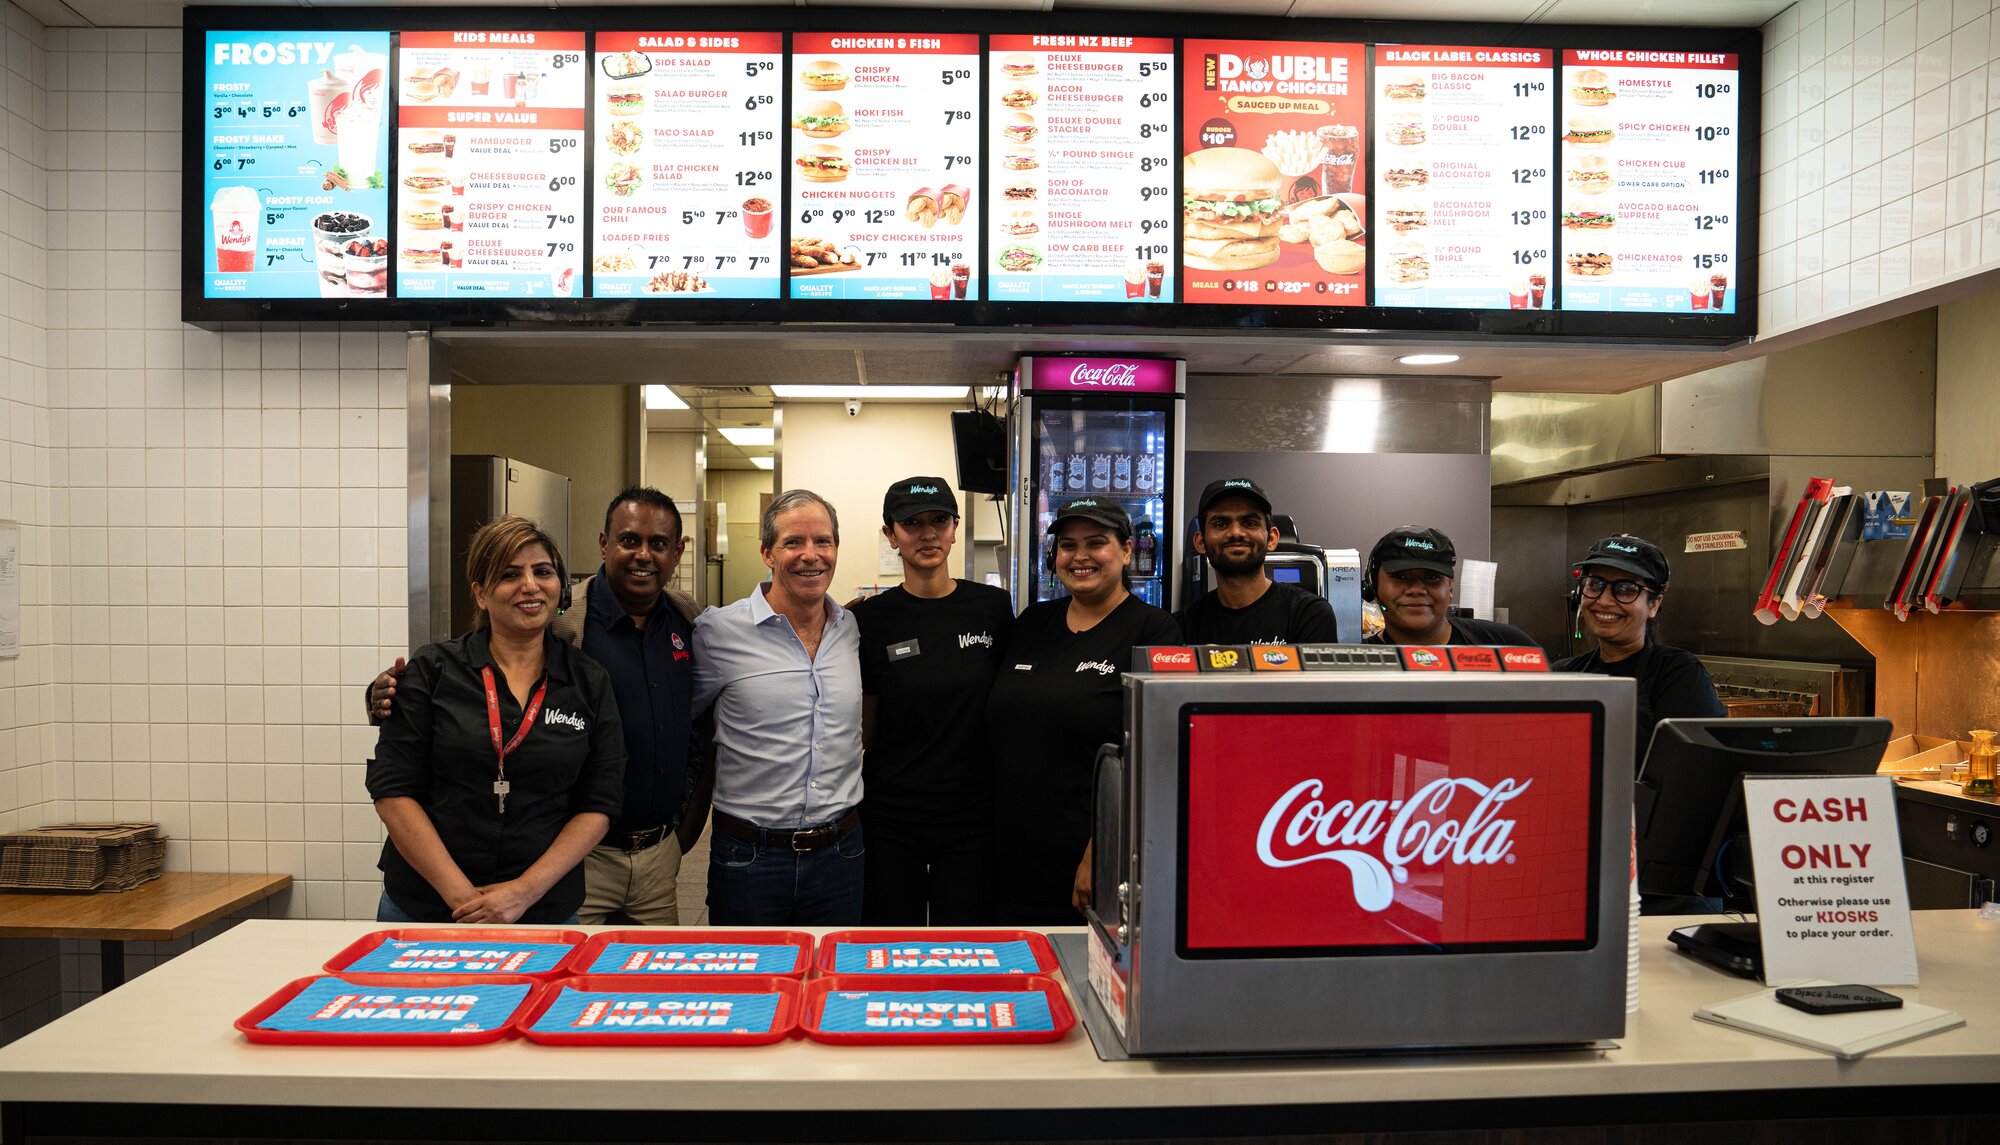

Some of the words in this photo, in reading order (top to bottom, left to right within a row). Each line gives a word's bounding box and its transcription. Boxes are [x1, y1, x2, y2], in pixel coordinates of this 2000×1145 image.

[454, 32, 487, 43] KIDS
[490, 33, 535, 44] MEALS
[638, 37, 685, 47] SALAD
[687, 38, 697, 47] &
[700, 37, 740, 48] SIDES
[1033, 36, 1076, 47] FRESH
[1079, 37, 1099, 47] NZ
[1102, 37, 1133, 47] BEEF
[831, 38, 894, 49] CHICKEN
[898, 39, 907, 49] &
[910, 39, 941, 49] FISH
[214, 42, 334, 65] FROSTY
[1386, 51, 1431, 62] BLACK
[1434, 52, 1472, 62] LABEL
[1475, 52, 1541, 63] CLASSICS
[1576, 51, 1623, 61] WHOLE
[1626, 51, 1685, 63] CHICKEN
[1688, 53, 1726, 64] FILLET
[655, 59, 676, 67] SIDE
[679, 59, 711, 67] SALAD
[1048, 64, 1123, 72] CHEESEBURGER
[1206, 58, 1216, 86] NEW
[1220, 54, 1348, 82] DUBLE
[1220, 80, 1275, 93] TANGY
[1277, 81, 1348, 96] CHICKEN
[1432, 82, 1472, 90] CLASSIC
[1619, 80, 1672, 88] HOMESTYLE
[655, 90, 686, 98] SALAD
[689, 90, 728, 98] BURGER
[1048, 94, 1123, 102] CHEESEBURGER
[1238, 101, 1277, 109] SAUCED
[1279, 102, 1292, 110] UP
[1293, 103, 1319, 111] MEAL
[855, 109, 879, 117] HOKI
[882, 109, 904, 117] FISH
[448, 112, 492, 123] SUPER
[495, 113, 537, 124] VALUE
[1048, 117, 1083, 125] DELUXE
[1086, 117, 1122, 125] DOUBLE
[1048, 126, 1091, 134] STACKER
[1619, 123, 1646, 131] SPICY
[1648, 124, 1690, 132] CHICKEN
[654, 129, 680, 137] TACO
[683, 129, 714, 137] SALAD
[214, 136, 251, 144] FROSTY
[253, 135, 284, 143] SHAKE
[470, 138, 532, 146] HAMBURGER
[855, 149, 891, 157] CRISPY
[1100, 151, 1134, 159] SINGLE
[855, 158, 899, 166] CHICKEN
[903, 158, 918, 166] BLT
[1619, 160, 1660, 168] CHICKEN
[470, 173, 546, 181] CHEESEBURGER
[1433, 170, 1491, 178] BACONATOR
[802, 191, 847, 199] CHICKEN
[850, 191, 896, 199] NUGGETS
[1048, 188, 1109, 196] BACONATOR
[266, 197, 304, 205] FROSTY
[305, 196, 334, 205] FLOAT
[508, 204, 552, 212] CHICKEN
[1618, 203, 1664, 211] AVOCADO
[469, 212, 507, 220] BURGER
[1048, 211, 1082, 219] SINGLE
[221, 234, 251, 245] Wendy's
[266, 237, 305, 246] PARFAIT
[603, 234, 640, 242] LOADED
[643, 234, 670, 242] FRIES
[850, 234, 879, 242] SPICY
[883, 234, 927, 242] CHICKEN
[468, 249, 543, 257] CHEESEBURGER
[1618, 254, 1683, 262] CHICKENATOR
[1236, 280, 1259, 292] $18
[1070, 363, 1140, 386] Coca-Cola
[958, 631, 993, 649] Wendy's
[1075, 660, 1115, 675] Wendy's
[545, 708, 585, 731] Wendy's
[1773, 797, 1868, 823] CASH
[1256, 776, 1533, 912] Coca-Cola
[1781, 844, 1871, 870] ONLY
[1793, 875, 1804, 884] at
[1807, 875, 1828, 884] this
[1831, 875, 1874, 886] register
[1778, 897, 1833, 907] Otherwise
[1836, 897, 1870, 908] please
[1873, 898, 1890, 906] use
[1795, 914, 1813, 922] our
[1816, 911, 1878, 923] KIOSKS
[1787, 929, 1798, 938] to
[1801, 929, 1828, 940] place
[1832, 929, 1857, 940] your
[1860, 929, 1893, 938] order.
[647, 963, 758, 971] NAME
[893, 959, 1000, 968] NAME
[340, 1009, 470, 1021] NAME
[603, 1015, 730, 1026] NAME
